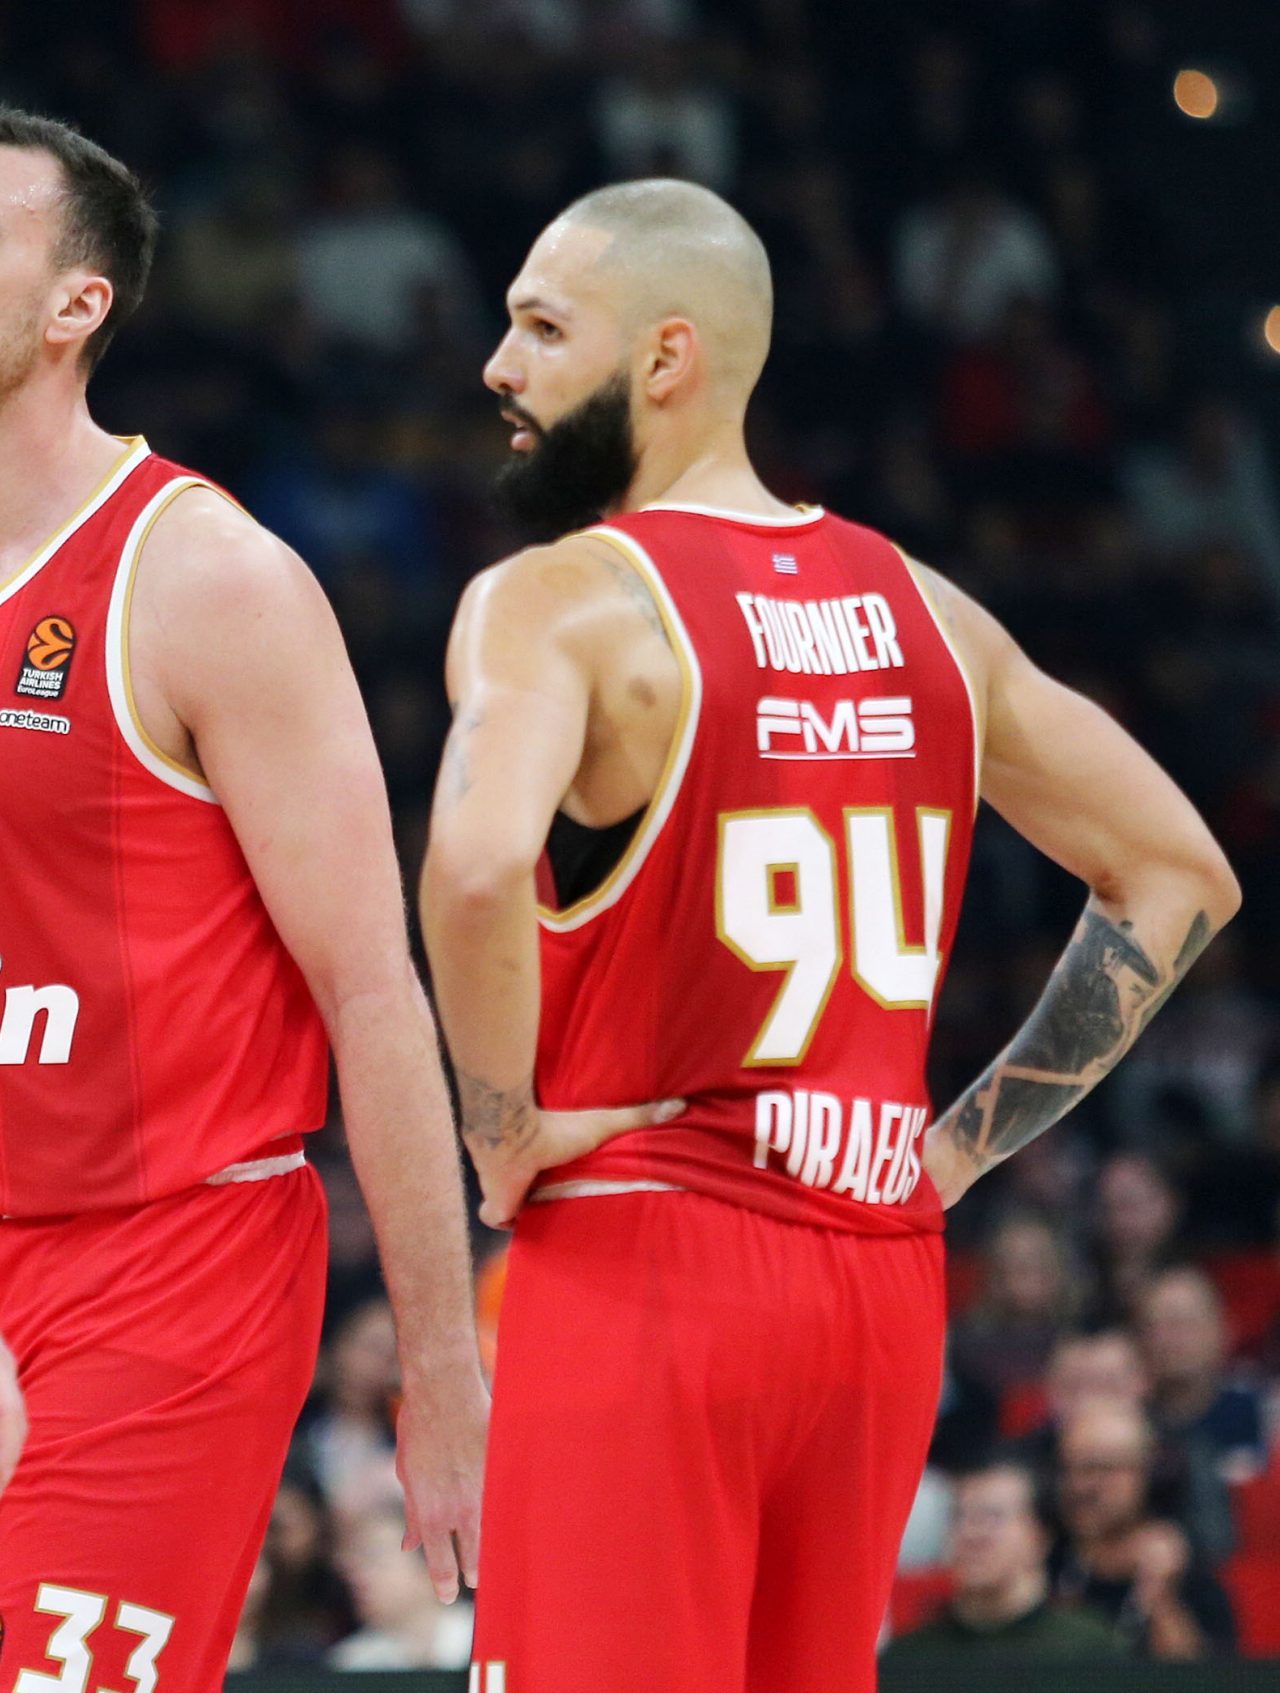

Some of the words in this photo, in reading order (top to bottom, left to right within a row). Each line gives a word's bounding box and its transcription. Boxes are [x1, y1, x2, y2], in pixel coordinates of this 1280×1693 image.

[23, 668, 64, 681] TURKISH
[735, 591, 904, 675] FOURNIER
[20, 676, 61, 690] AIRLINES
[756, 696, 916, 753] FMS
[715, 806, 953, 1069] 94
[753, 1089, 928, 1206] PIRAEUS
[13, 1583, 176, 1693] 33
